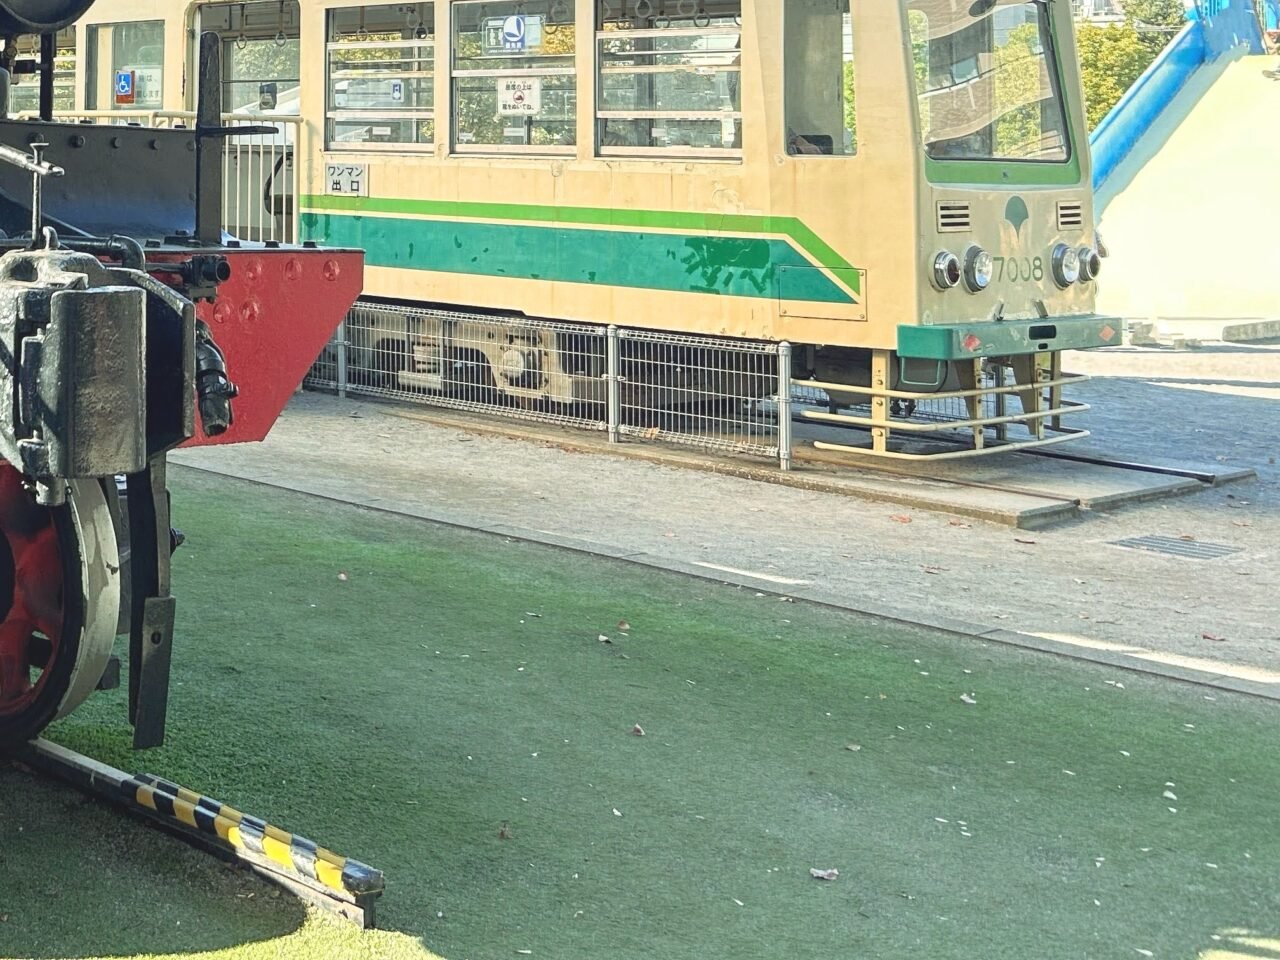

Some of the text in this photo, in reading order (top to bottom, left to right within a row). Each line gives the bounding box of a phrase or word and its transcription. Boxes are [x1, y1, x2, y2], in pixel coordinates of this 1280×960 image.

[327, 166, 363, 177] ワンマン
[992, 255, 1044, 283] 7008
